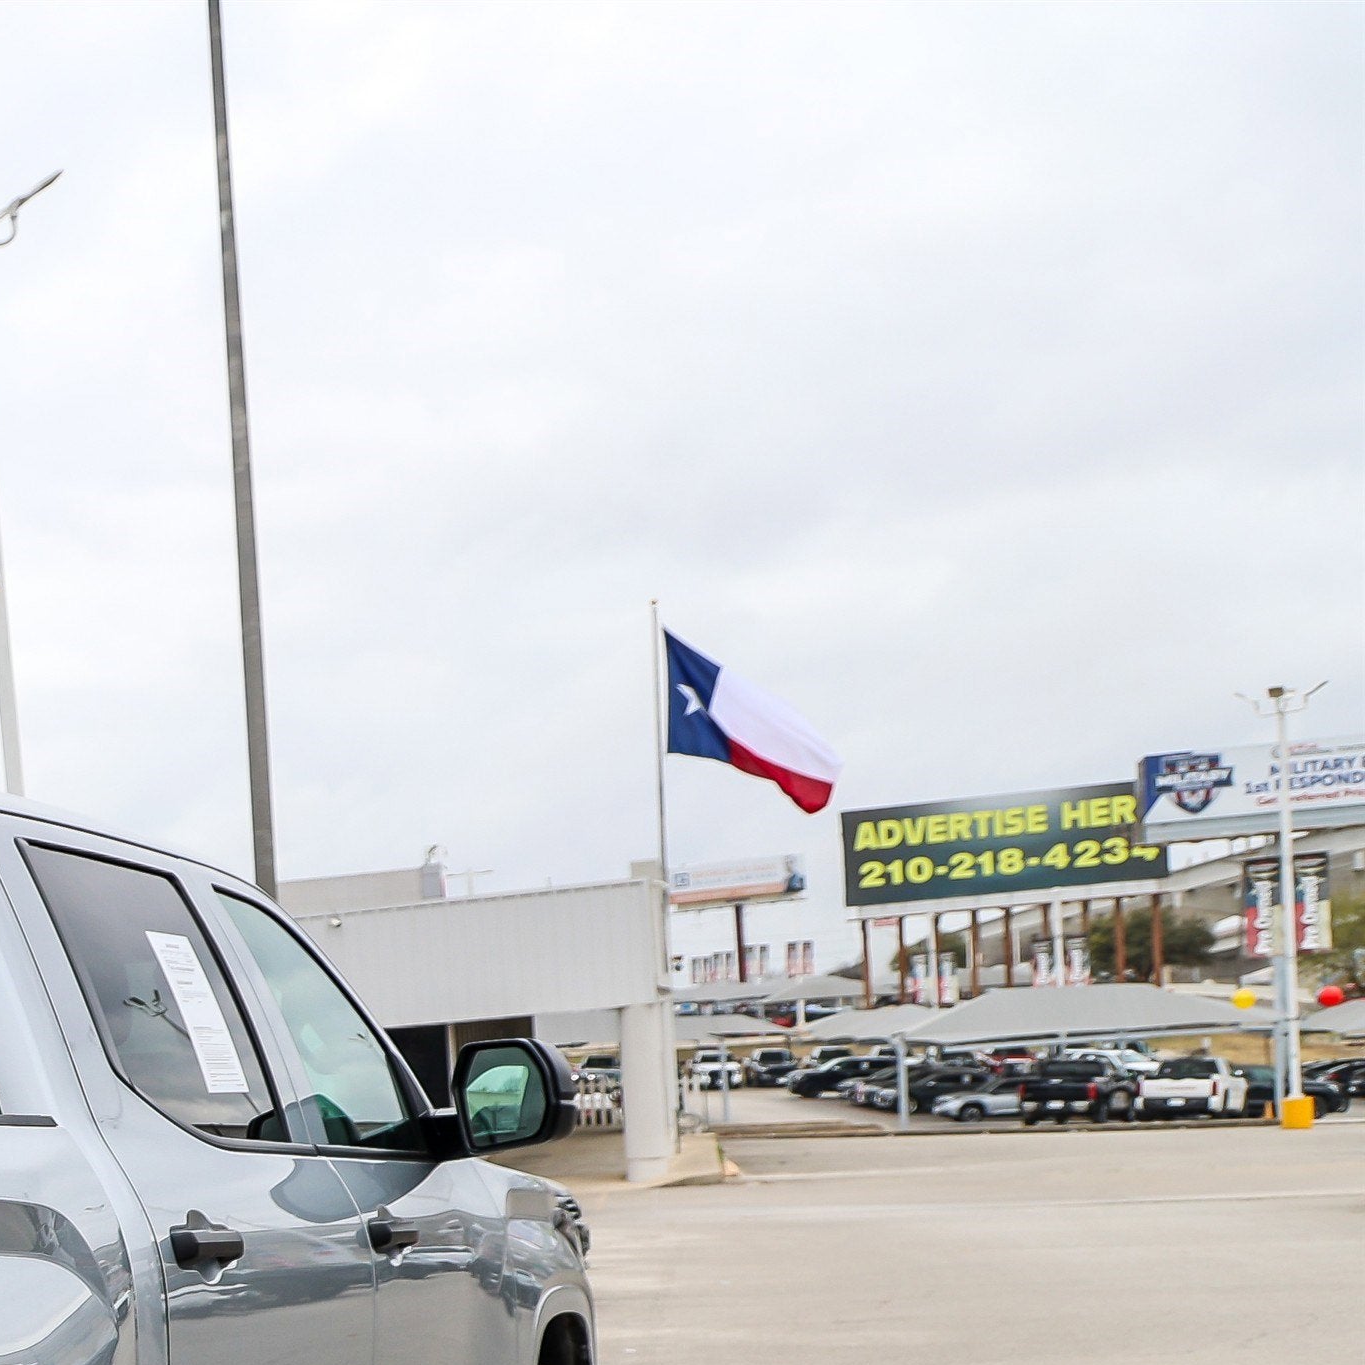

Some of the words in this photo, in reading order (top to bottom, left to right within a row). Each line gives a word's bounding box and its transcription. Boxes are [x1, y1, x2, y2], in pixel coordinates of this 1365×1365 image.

[1275, 771, 1365, 790] ESPOND
[853, 804, 1049, 851] ADVERTISE
[1060, 794, 1138, 832] HER
[858, 837, 1160, 889] 210-218-4234
